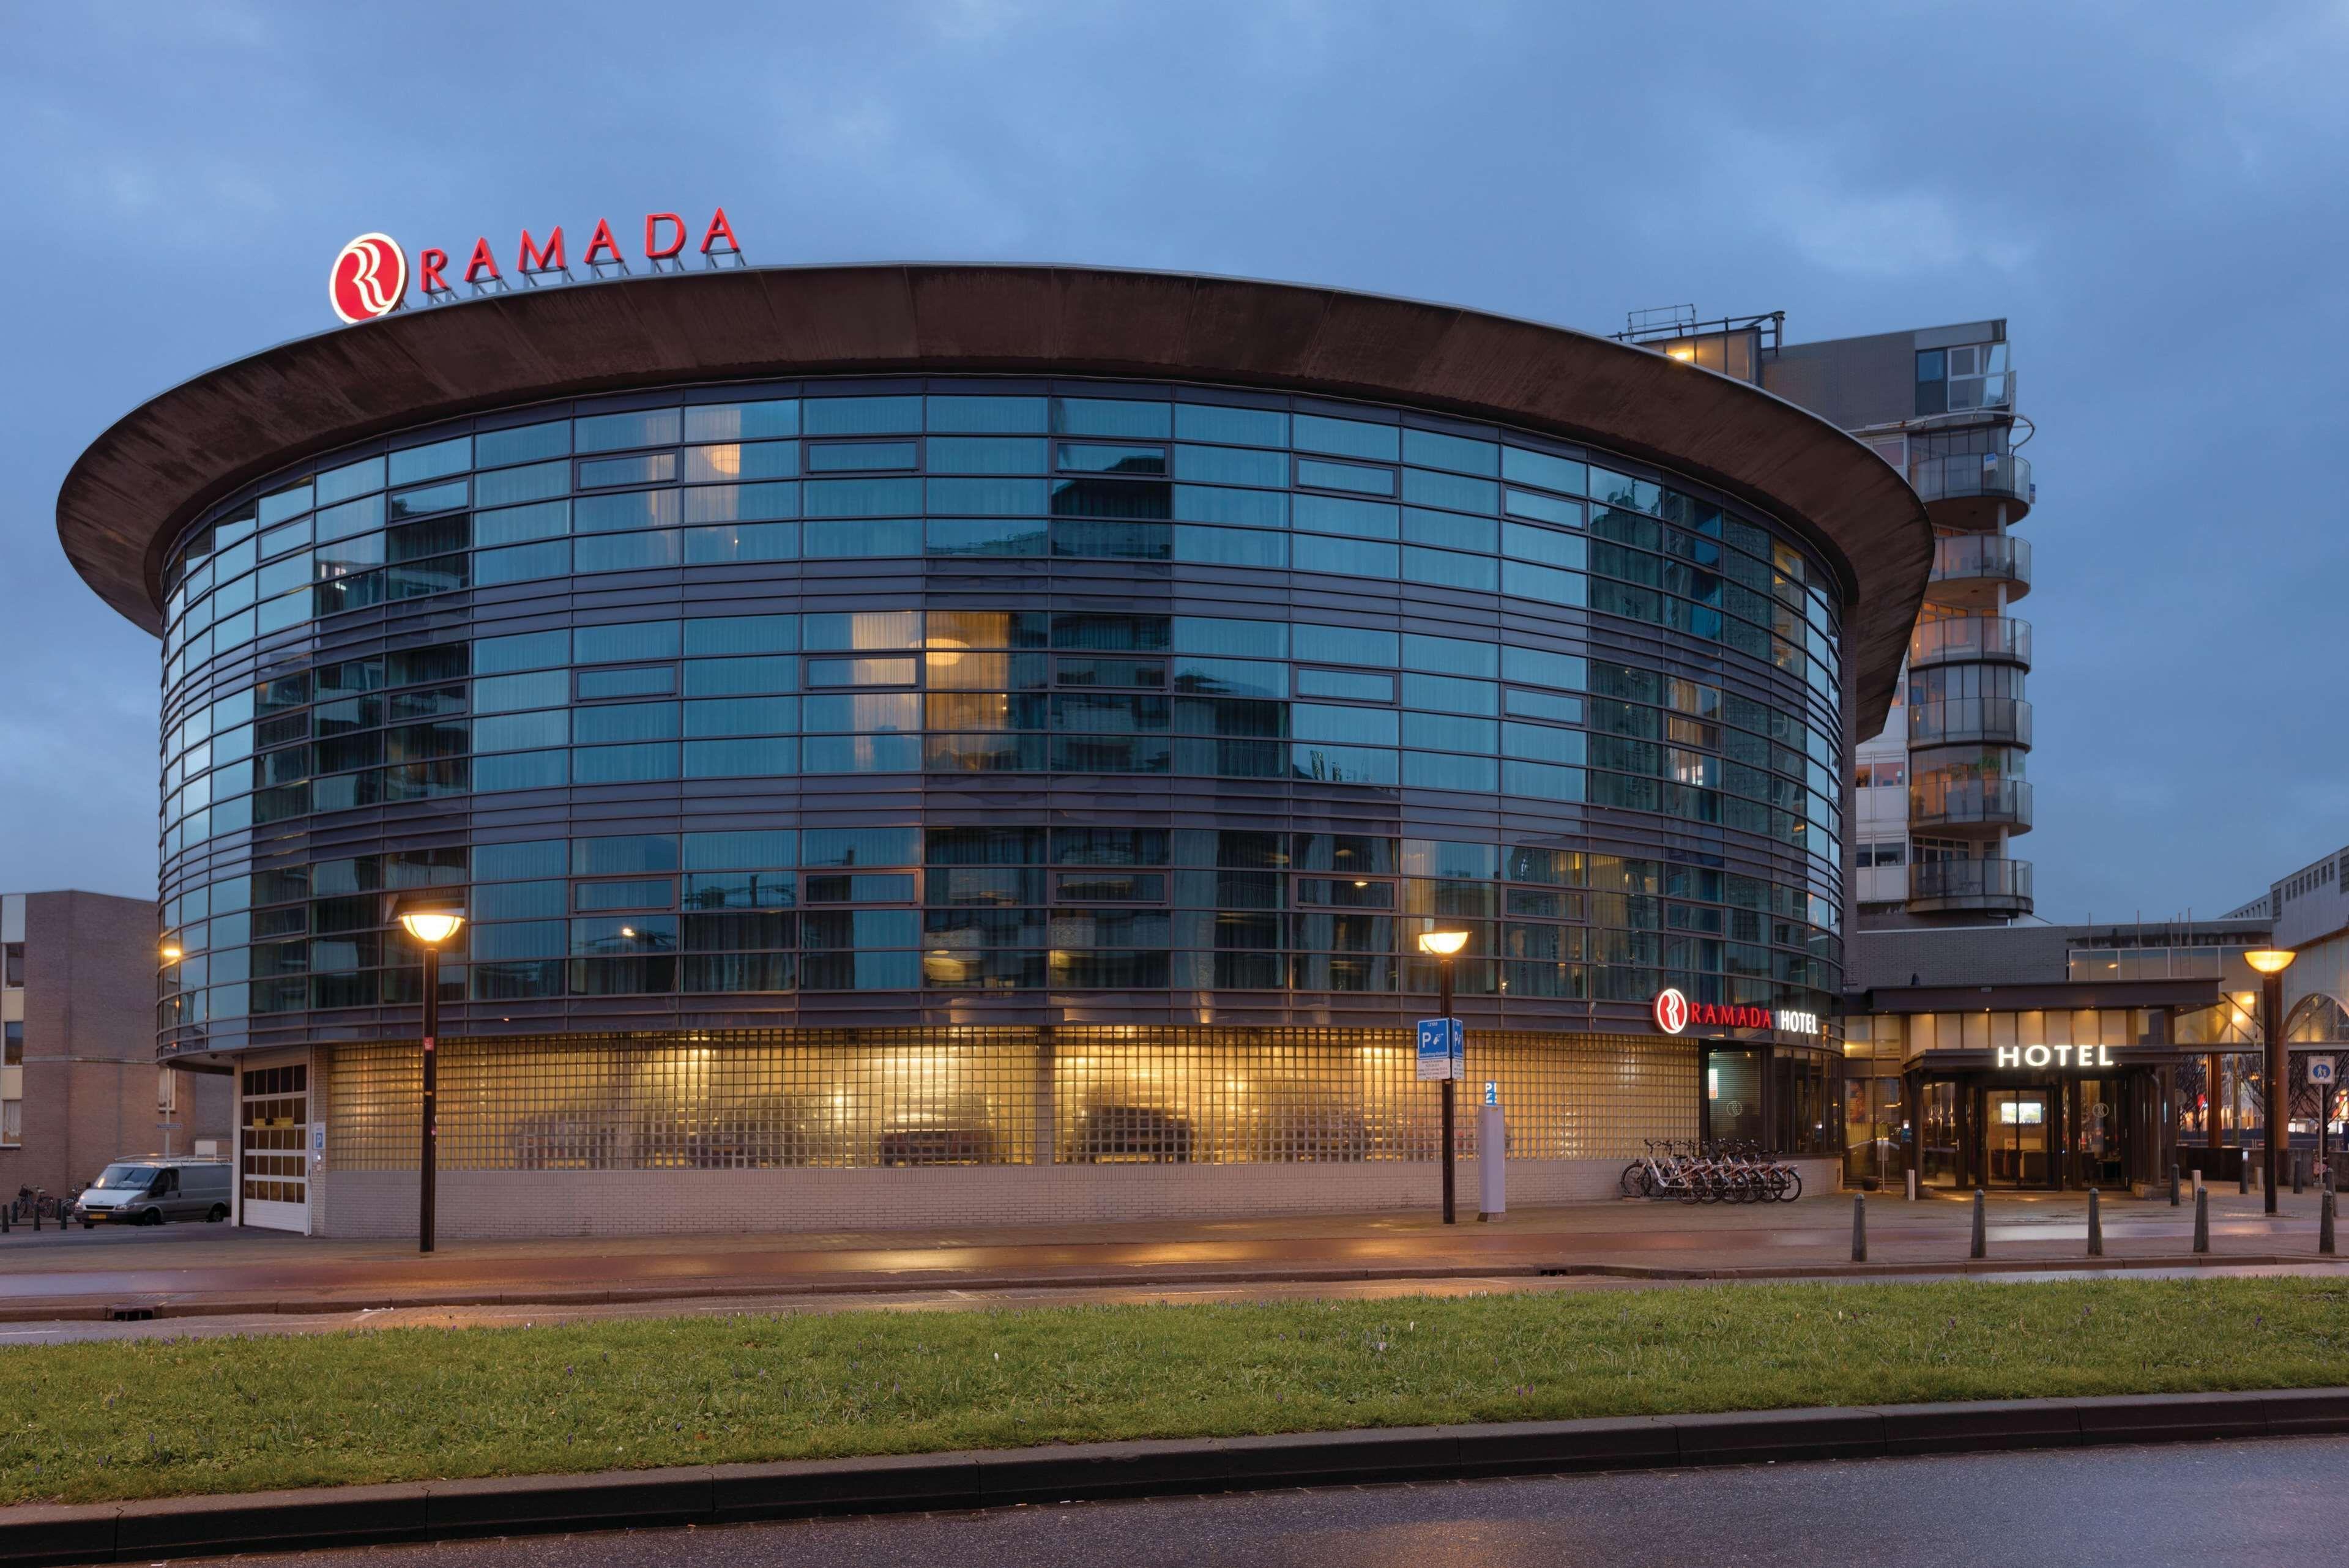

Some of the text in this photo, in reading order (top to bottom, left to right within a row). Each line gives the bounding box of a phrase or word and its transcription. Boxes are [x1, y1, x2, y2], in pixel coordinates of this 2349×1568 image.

[420, 207, 740, 292] RAMADA
[1691, 1001, 1772, 1029] RAMADA
[1781, 1009, 1819, 1035] HOTEL
[1998, 1044, 2114, 1067] HOTEL
